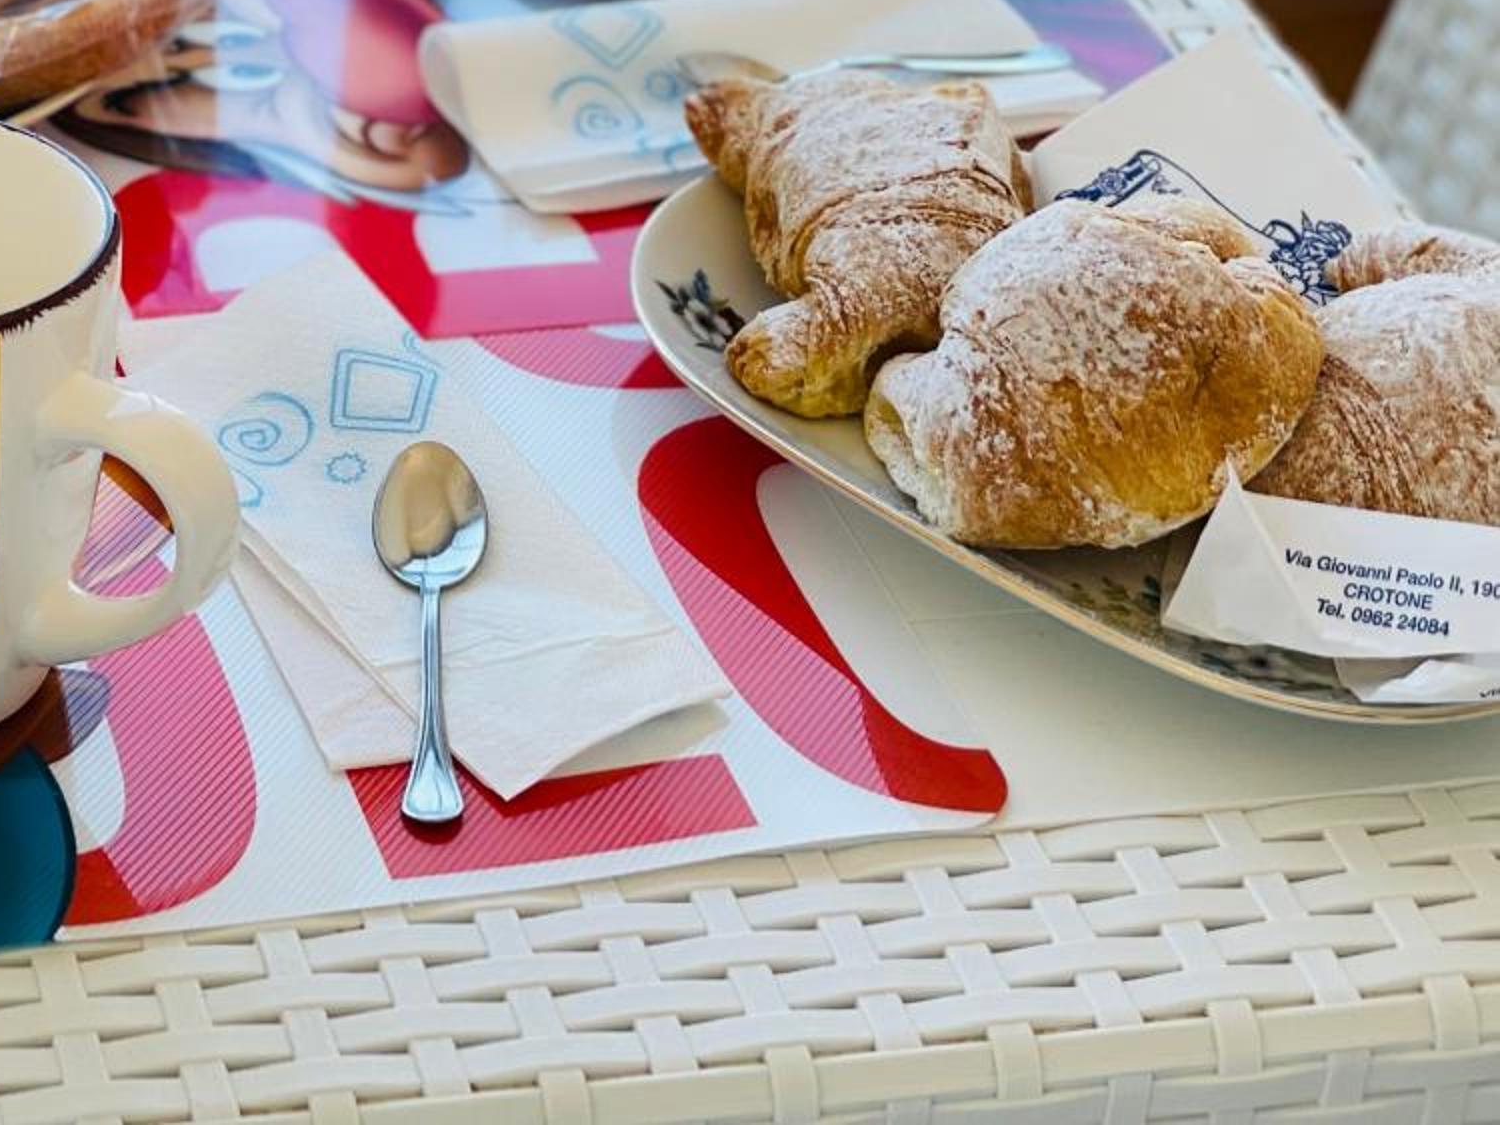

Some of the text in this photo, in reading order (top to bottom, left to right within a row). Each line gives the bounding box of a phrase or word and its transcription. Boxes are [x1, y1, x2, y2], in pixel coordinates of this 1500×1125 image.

[1284, 547, 1313, 569] Via
[1316, 554, 1393, 582] Giovanni
[1395, 567, 1445, 590] Paolo
[1342, 581, 1434, 611] CROTONE
[1316, 597, 1450, 637] Tel. 0962 24084
